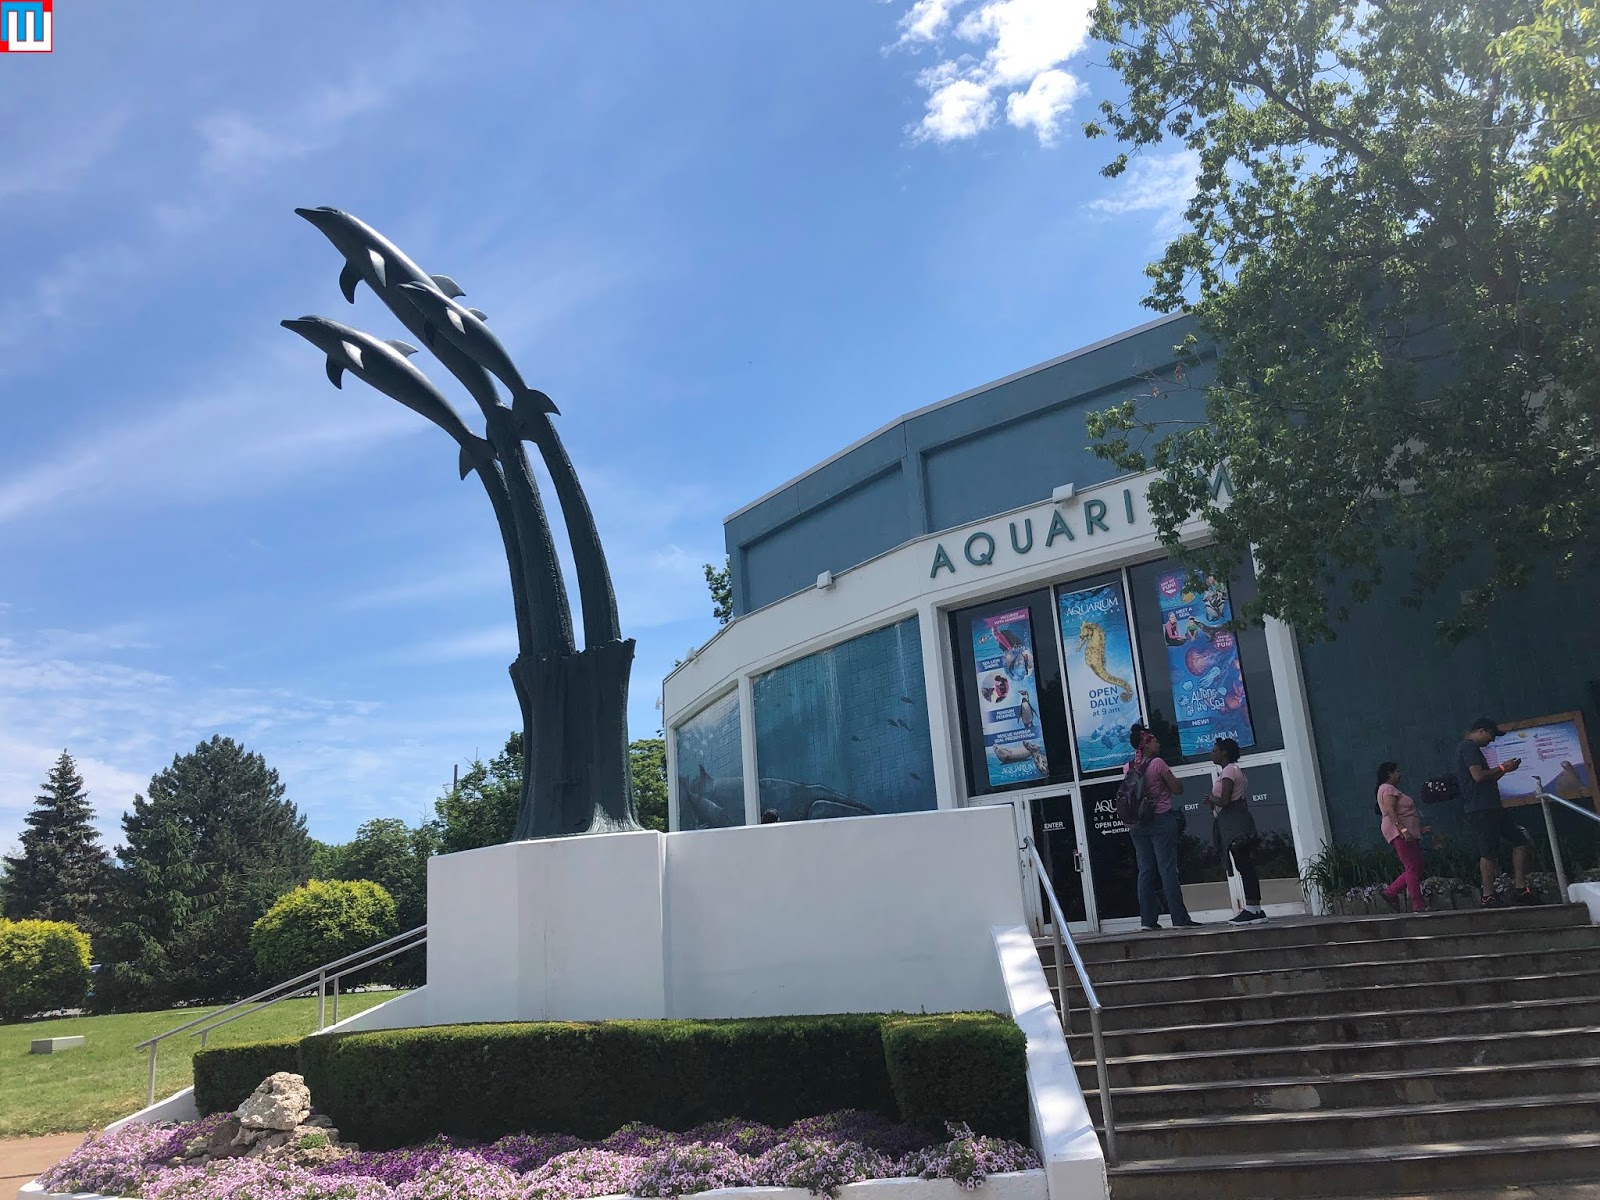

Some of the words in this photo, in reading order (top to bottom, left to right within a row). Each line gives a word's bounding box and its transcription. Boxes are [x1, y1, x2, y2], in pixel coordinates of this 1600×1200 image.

[929, 461, 1234, 578] AQUARIM
[1067, 596, 1119, 616] AQUARIUM
[1089, 685, 1118, 699] OPEN
[1090, 695, 1119, 708] DAILY
[1210, 698, 1225, 710] Sea
[1092, 709, 1100, 717] at
[1101, 707, 1107, 715] 9
[1184, 803, 1199, 811] EXIT
[1044, 821, 1064, 830] ENTER
[1094, 821, 1112, 829] OPEN
[1112, 819, 1124, 827] DAI
